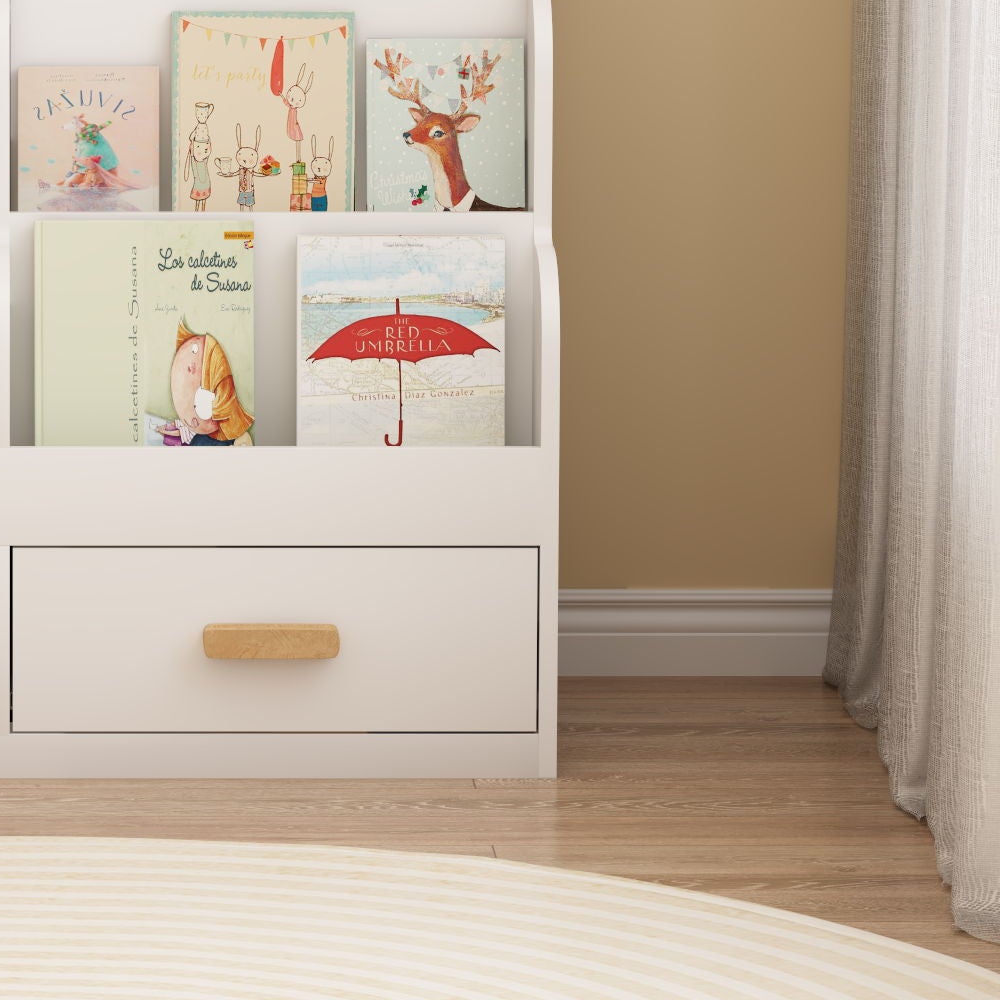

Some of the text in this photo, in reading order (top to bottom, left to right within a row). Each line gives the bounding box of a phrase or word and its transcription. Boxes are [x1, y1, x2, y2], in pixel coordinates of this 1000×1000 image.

[158, 247, 238, 271] Los calcetines
[191, 272, 251, 292] de Susana
[386, 326, 420, 339] RED
[128, 246, 140, 443] calcetines de Susana
[355, 339, 452, 354] UMBRELLA
